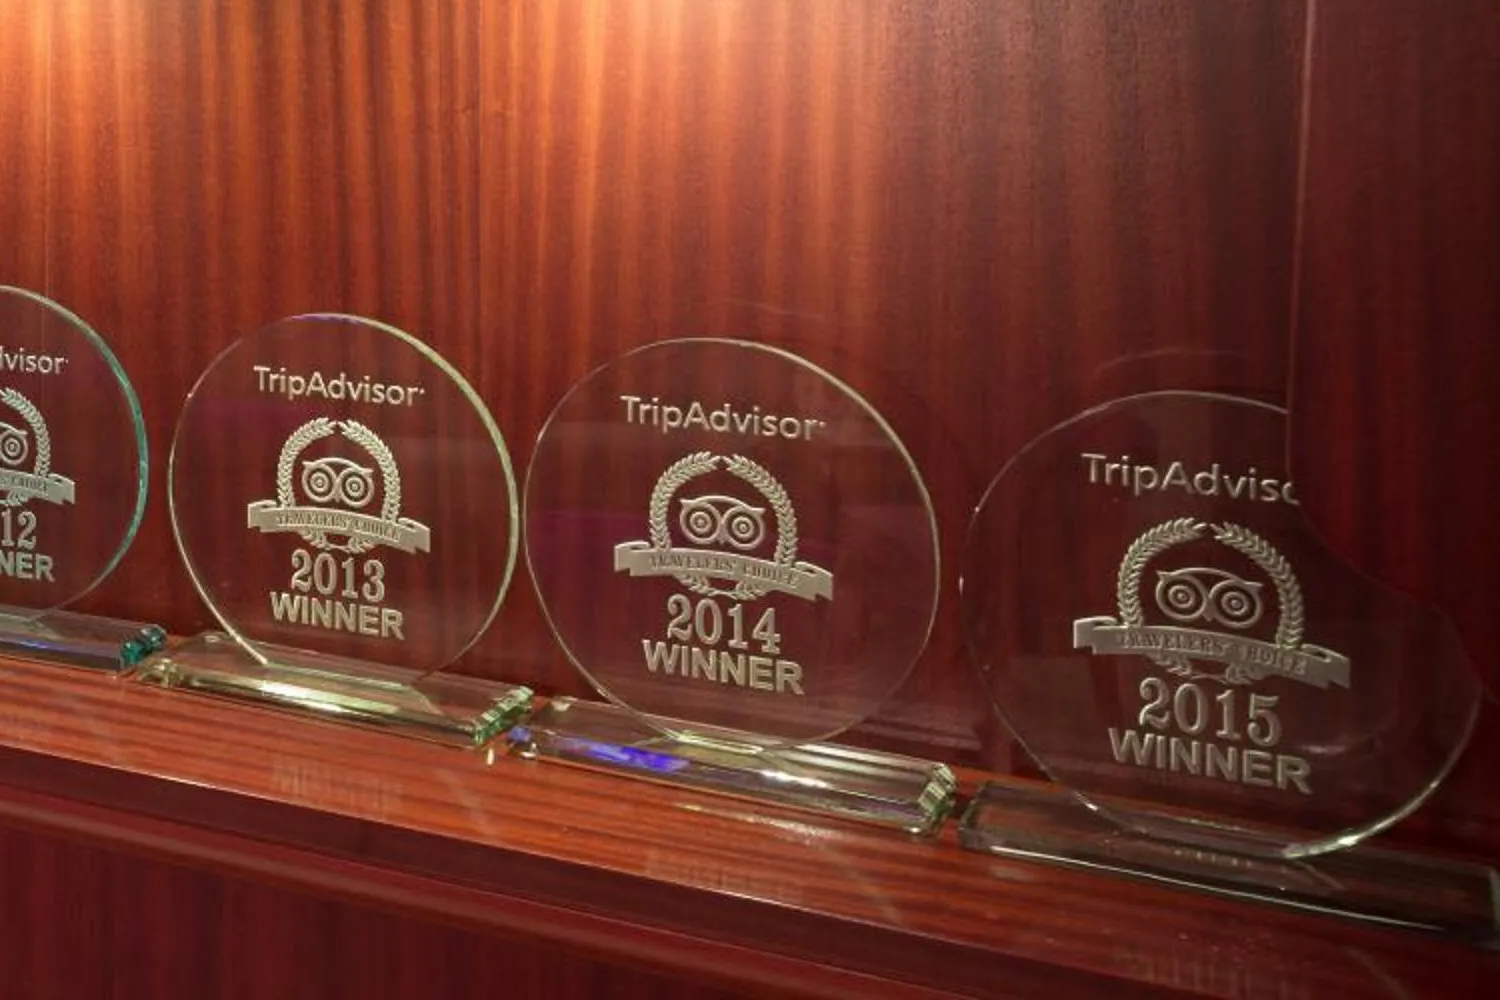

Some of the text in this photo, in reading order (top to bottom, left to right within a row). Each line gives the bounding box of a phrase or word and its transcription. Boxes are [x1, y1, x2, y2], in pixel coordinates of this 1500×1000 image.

[253, 364, 419, 406] TripAdvisor
[620, 394, 819, 440] TripAdvisor
[291, 549, 385, 603] 2013
[270, 591, 405, 641] WINNER
[667, 593, 781, 655] 2014
[642, 638, 805, 695] WINNER
[1138, 677, 1281, 747] 2015
[1107, 727, 1312, 794] WINNER
